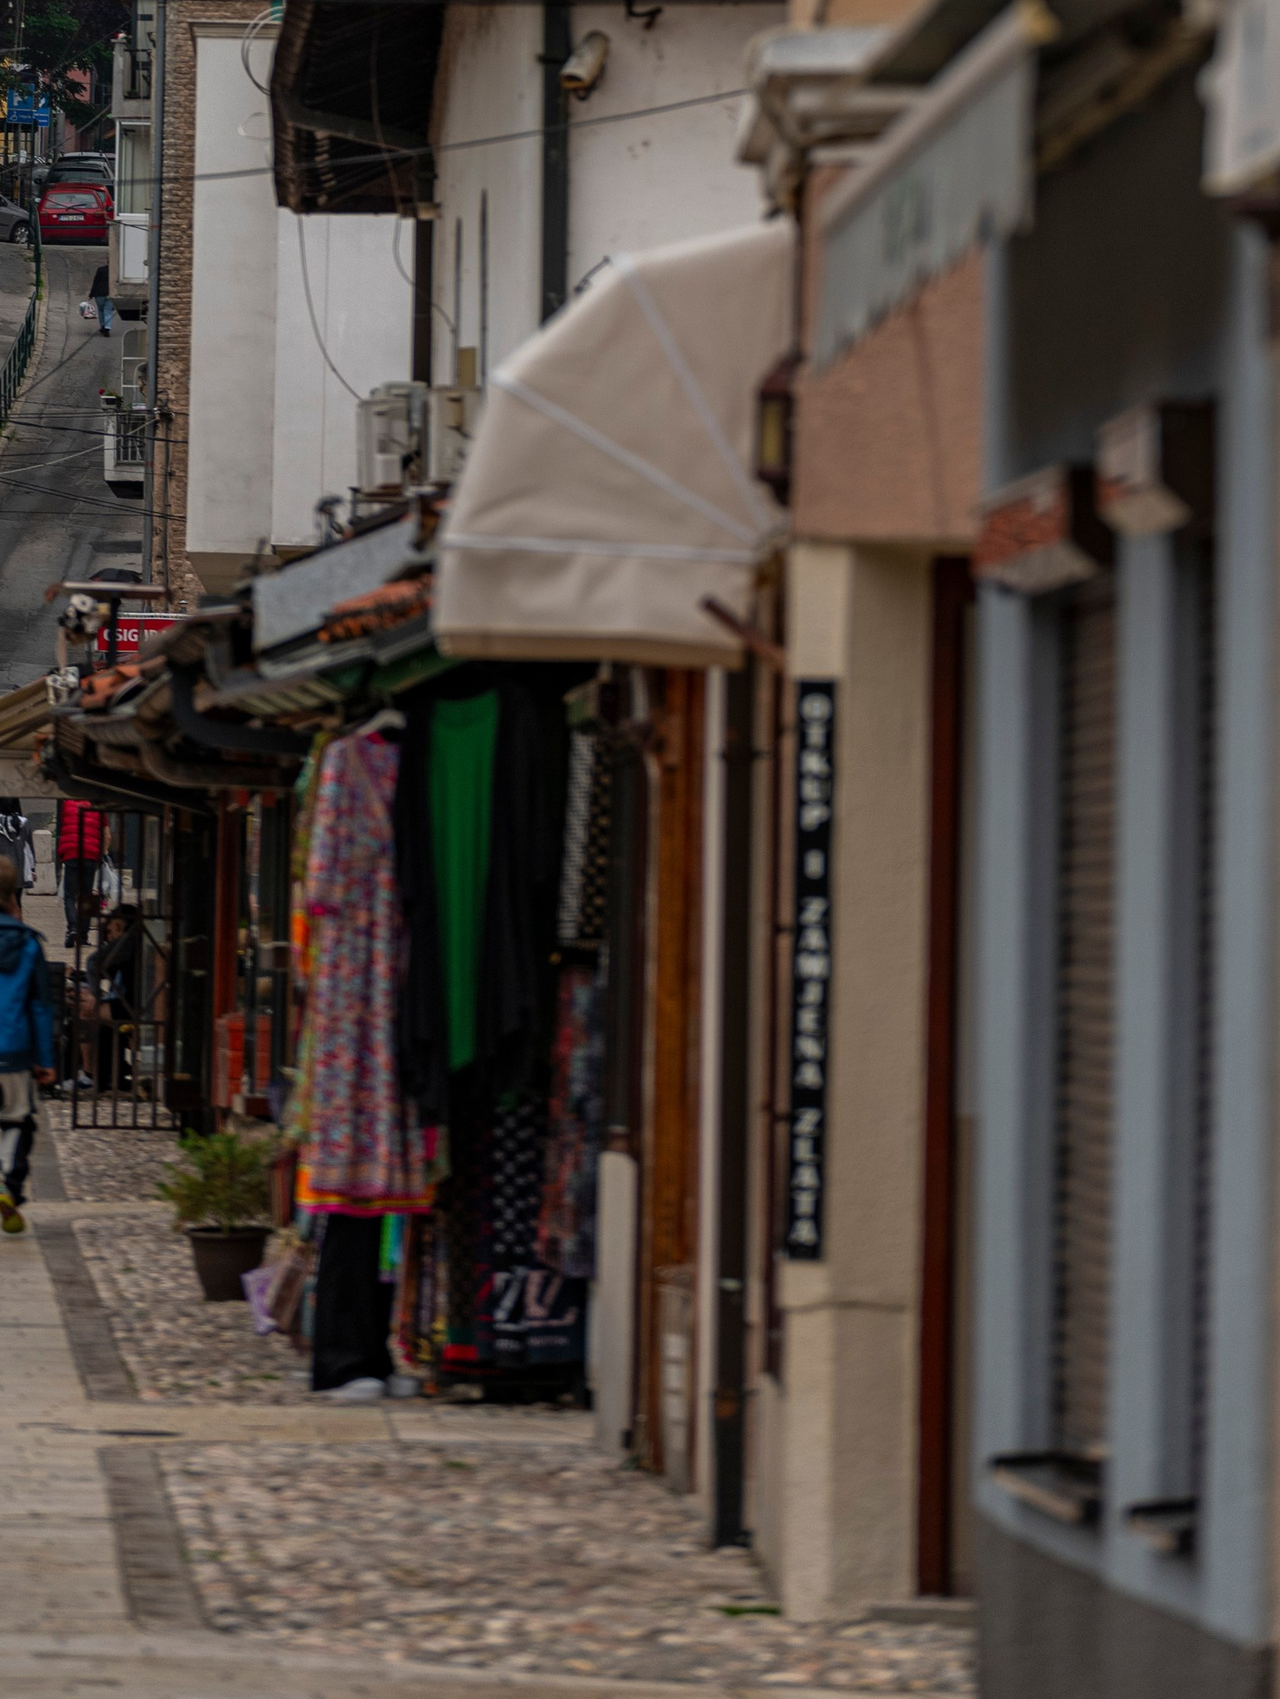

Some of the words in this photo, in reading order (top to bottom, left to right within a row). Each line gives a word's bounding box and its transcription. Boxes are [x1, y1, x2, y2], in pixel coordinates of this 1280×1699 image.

[799, 692, 833, 832] OTKUP
[793, 896, 831, 1090] ZAMJENA
[787, 1106, 823, 1247] ZLATA
